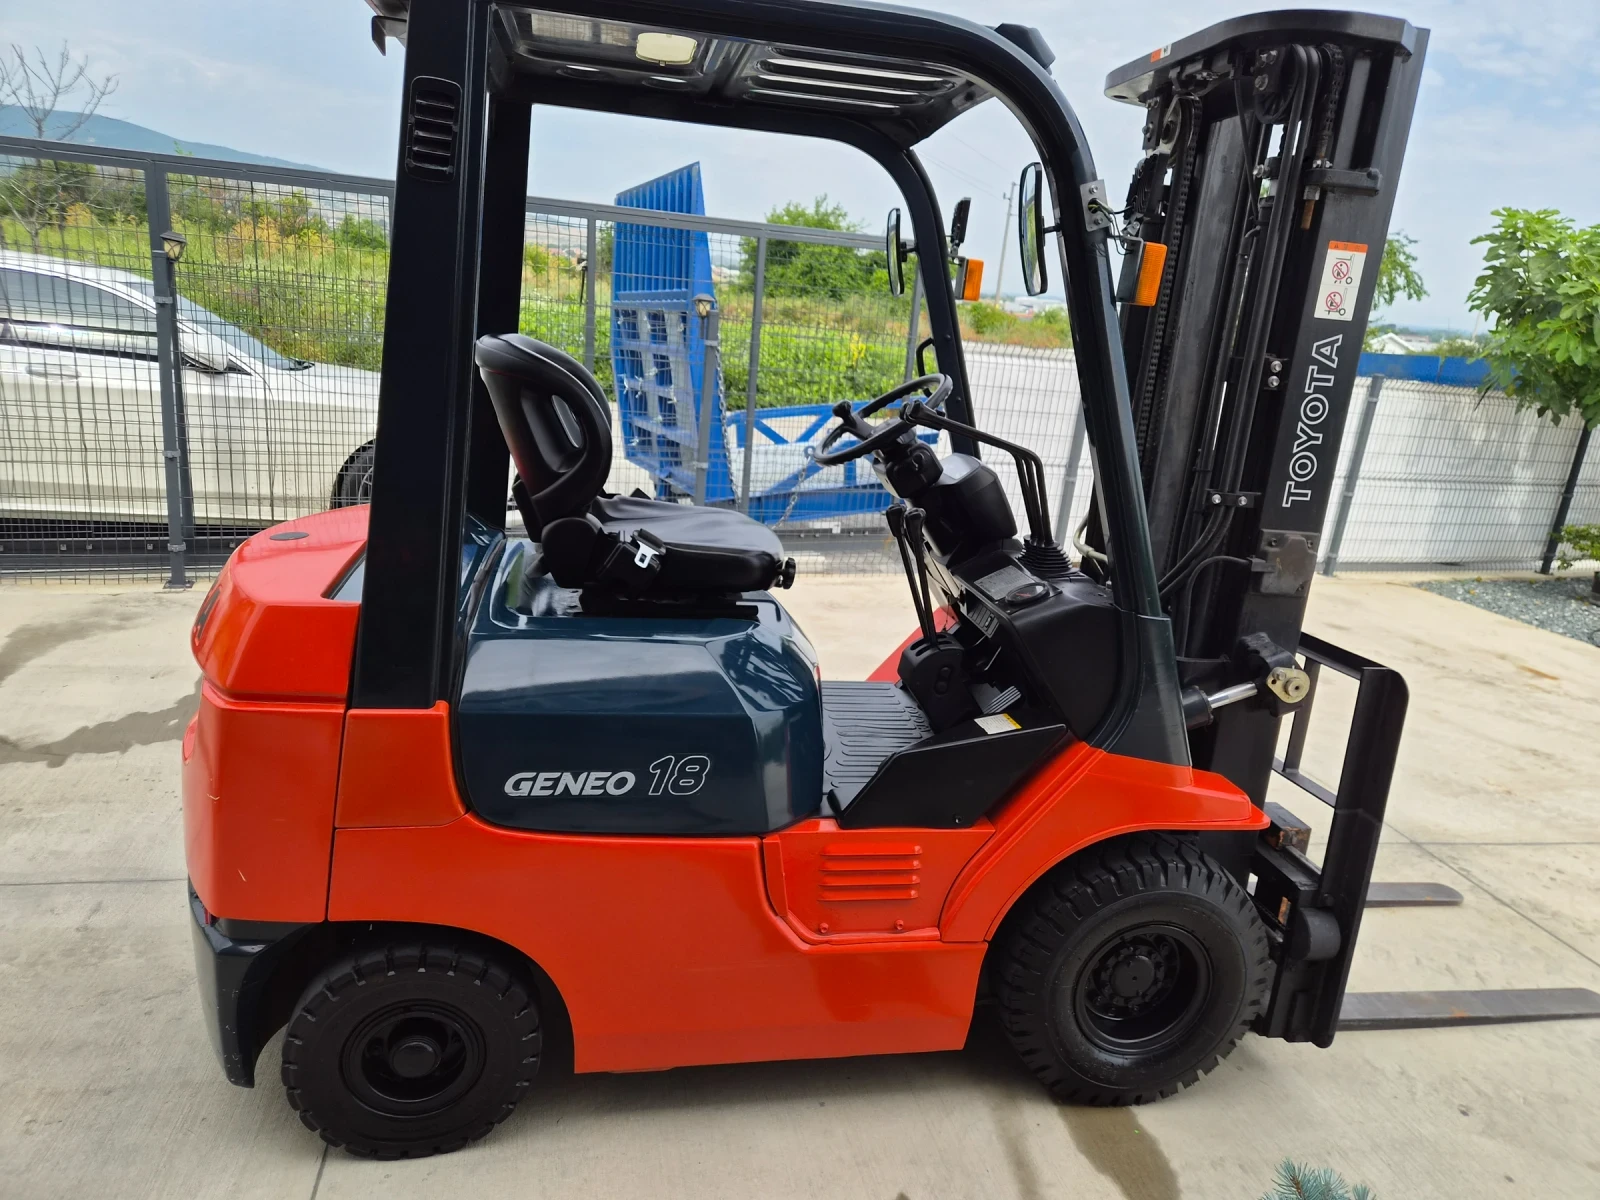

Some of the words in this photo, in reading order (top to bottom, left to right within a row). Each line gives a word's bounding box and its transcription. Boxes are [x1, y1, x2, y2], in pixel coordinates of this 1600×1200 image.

[1282, 334, 1343, 508] TOYOTA
[504, 771, 636, 796] GENEO
[648, 755, 710, 795] 18
